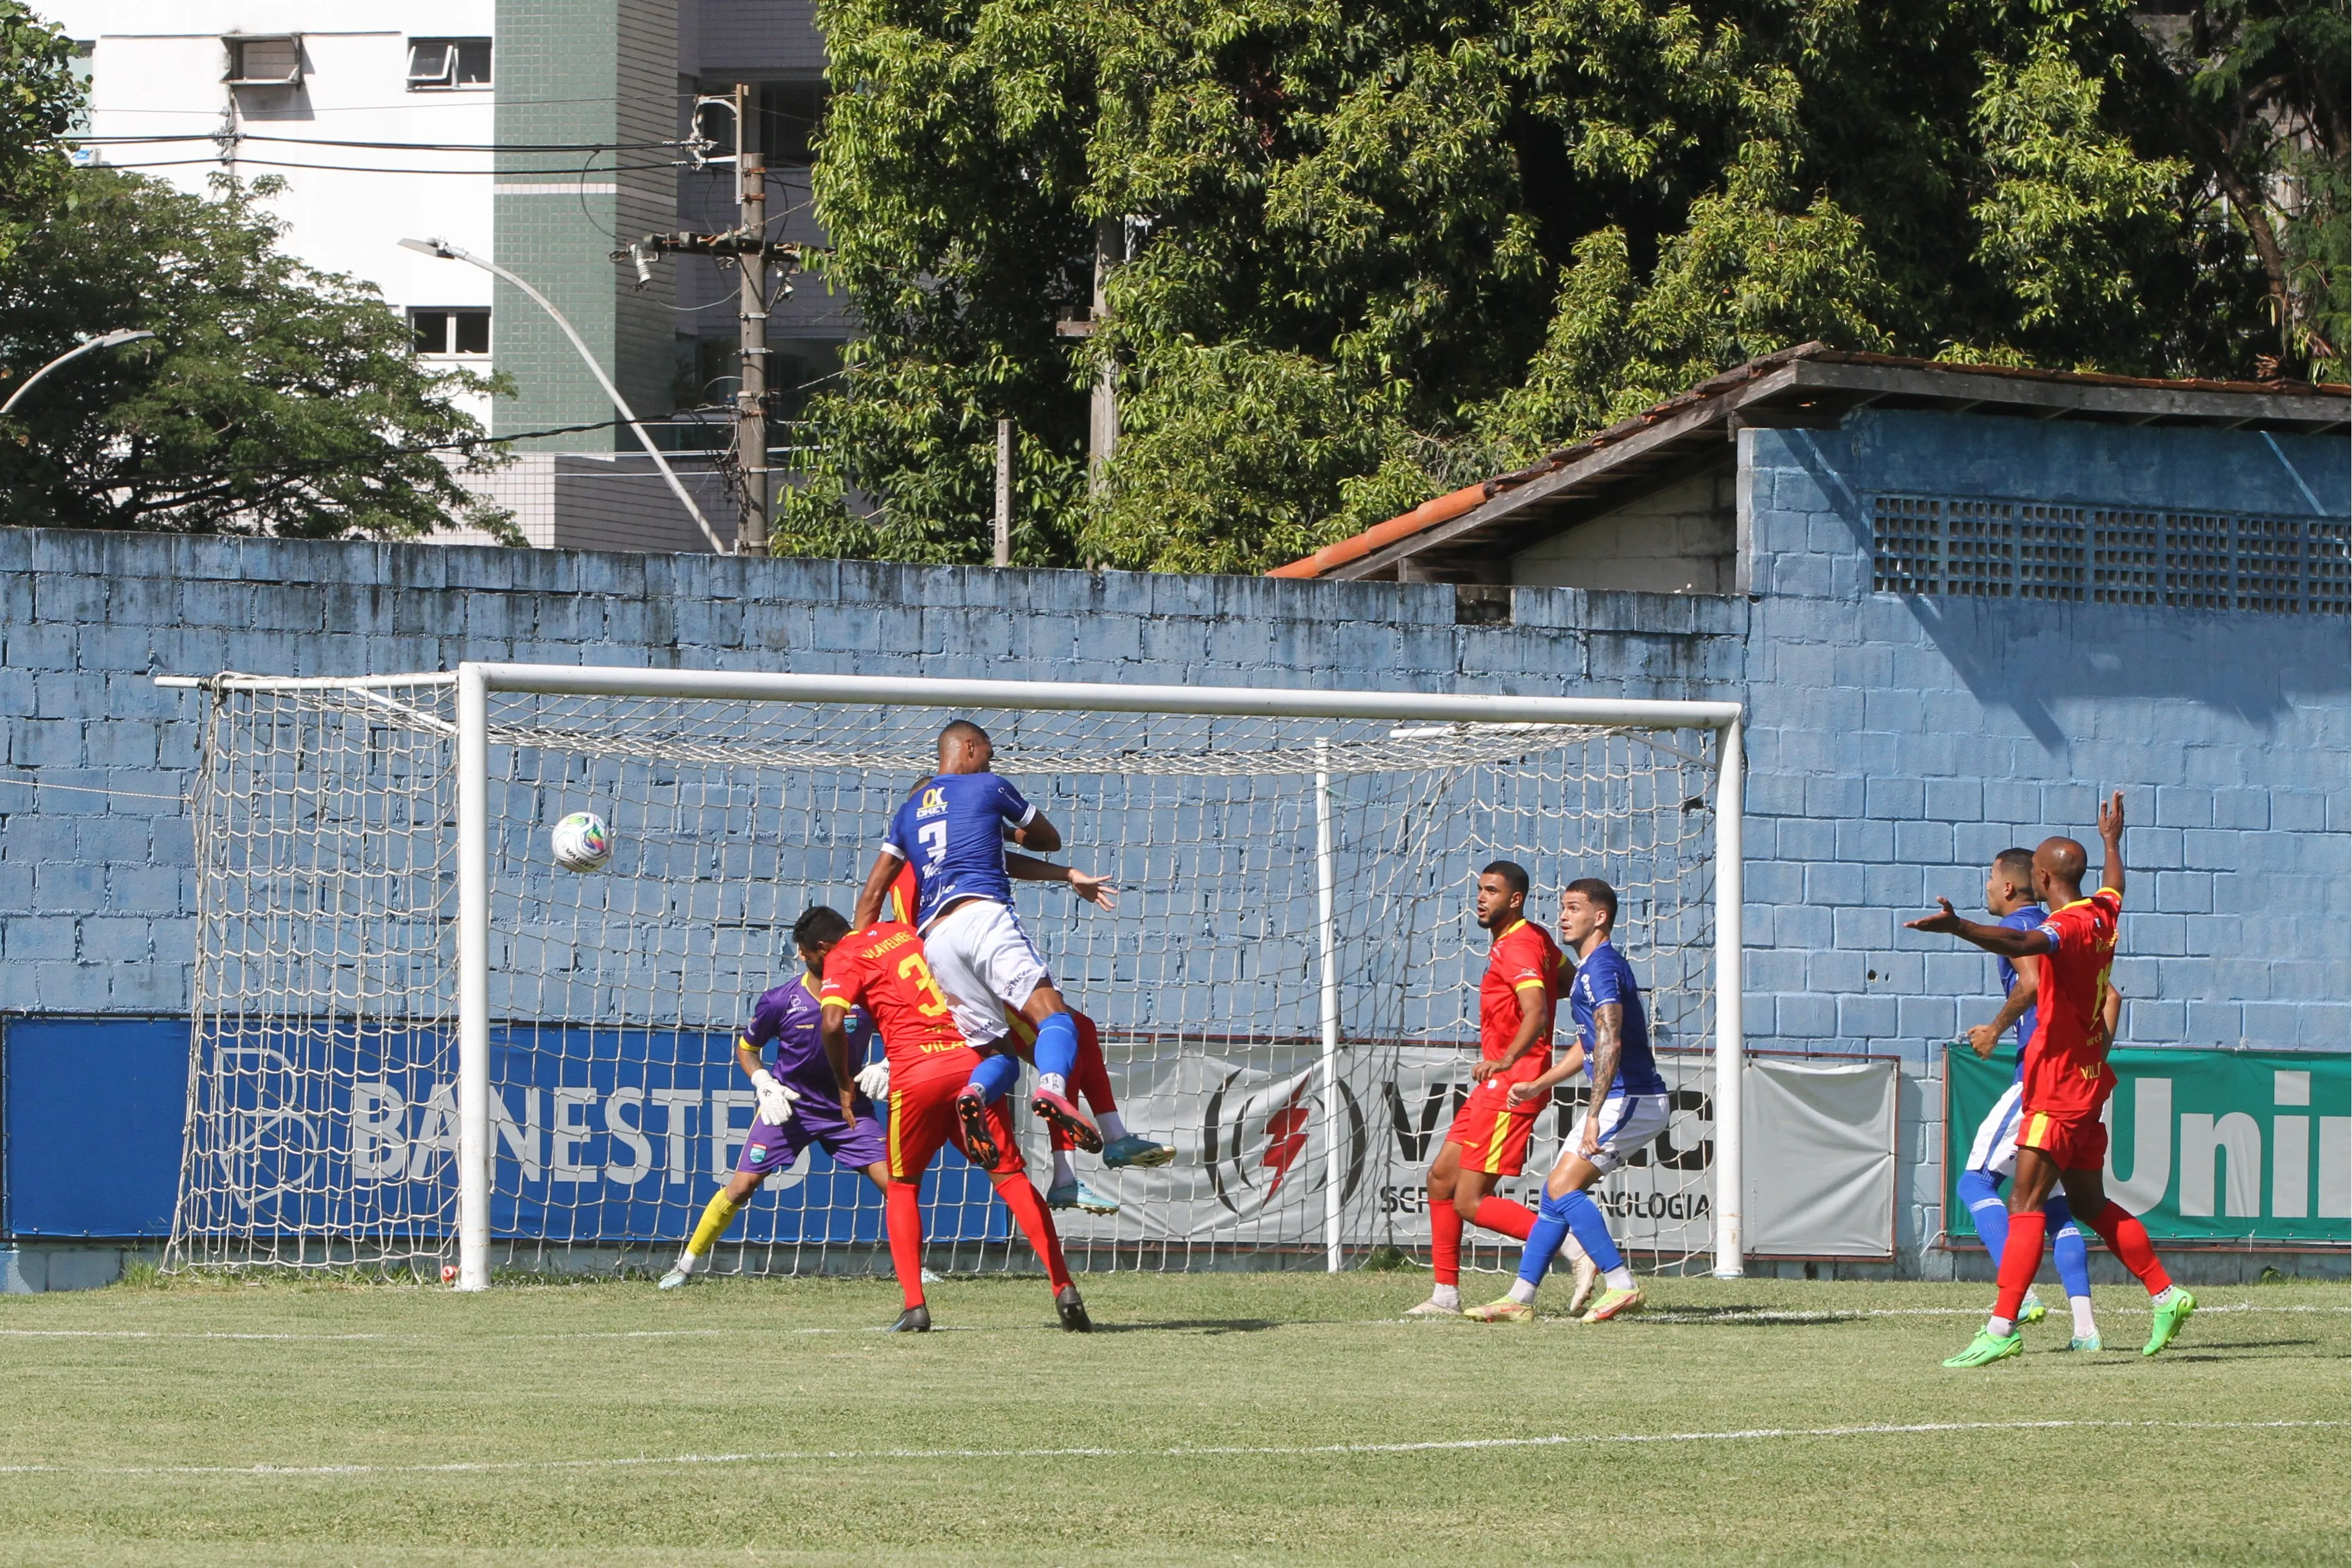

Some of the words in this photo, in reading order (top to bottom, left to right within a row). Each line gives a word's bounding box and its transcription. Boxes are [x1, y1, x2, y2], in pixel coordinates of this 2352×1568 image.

[916, 804, 948, 819] OKEY
[898, 952, 948, 1017] 3
[354, 1082, 811, 1191] BANESTE
